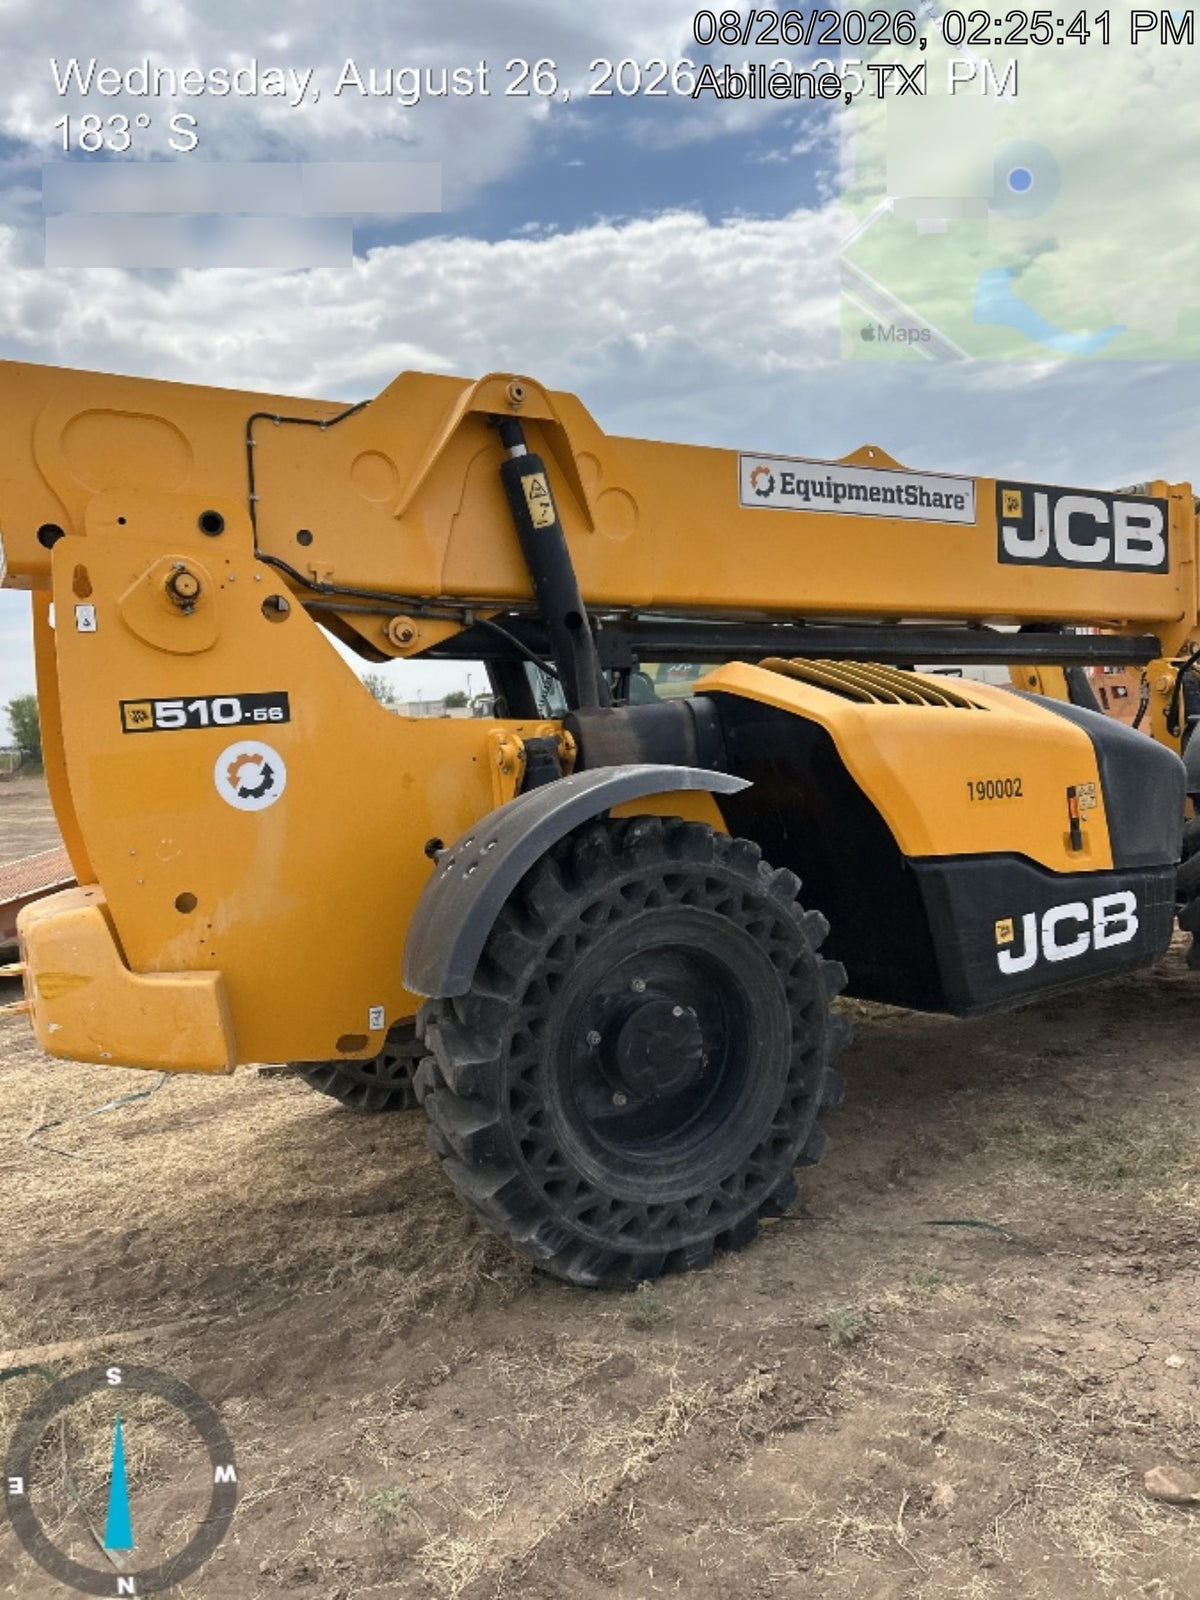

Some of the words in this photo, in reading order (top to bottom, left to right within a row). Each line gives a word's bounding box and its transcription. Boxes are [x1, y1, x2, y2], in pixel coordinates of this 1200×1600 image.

[779, 471, 966, 511] EquipmentShare
[1002, 492, 1166, 567] JCB
[967, 778, 1023, 801] 190002
[996, 890, 1139, 975] JCB
